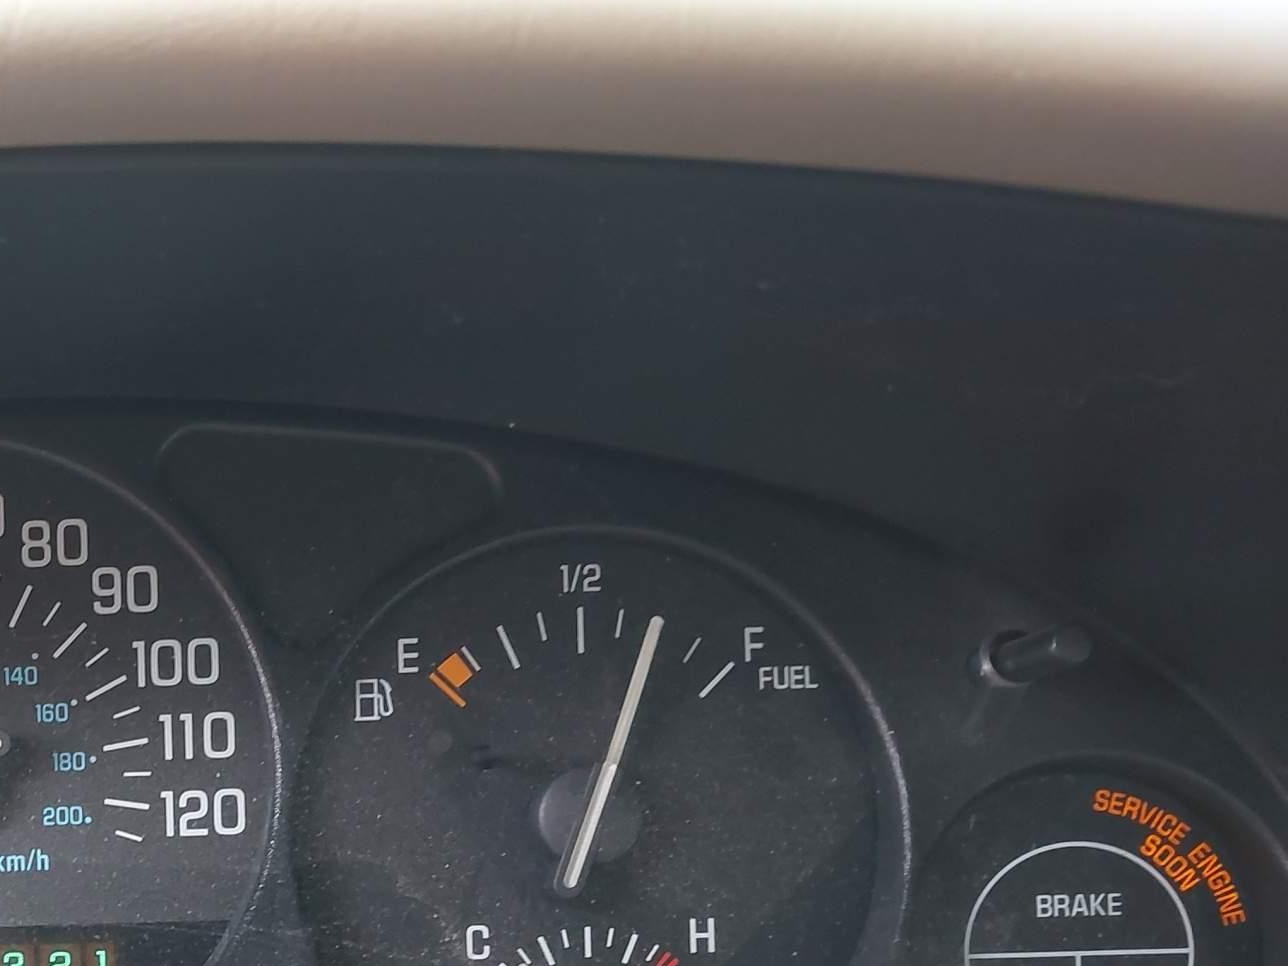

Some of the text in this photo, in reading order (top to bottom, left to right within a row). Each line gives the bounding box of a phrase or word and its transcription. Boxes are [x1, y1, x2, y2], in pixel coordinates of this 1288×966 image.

[21, 518, 89, 567] 80
[91, 565, 158, 615] 90
[559, 563, 602, 593] 1/2
[397, 638, 420, 674] E
[743, 626, 764, 662] F
[3, 666, 38, 687] 140
[132, 638, 219, 687] 100
[758, 665, 819, 691] FUEL
[35, 702, 69, 724] 160
[158, 711, 235, 761] 110
[52, 751, 86, 772] 180
[43, 805, 85, 826] 200
[160, 788, 247, 838] 120
[1092, 788, 1247, 927] SERVICE ENGINE
[1140, 834, 1203, 893] SOON
[1035, 893, 1123, 919] BRAKE
[465, 924, 491, 961] C
[689, 918, 716, 953] H
